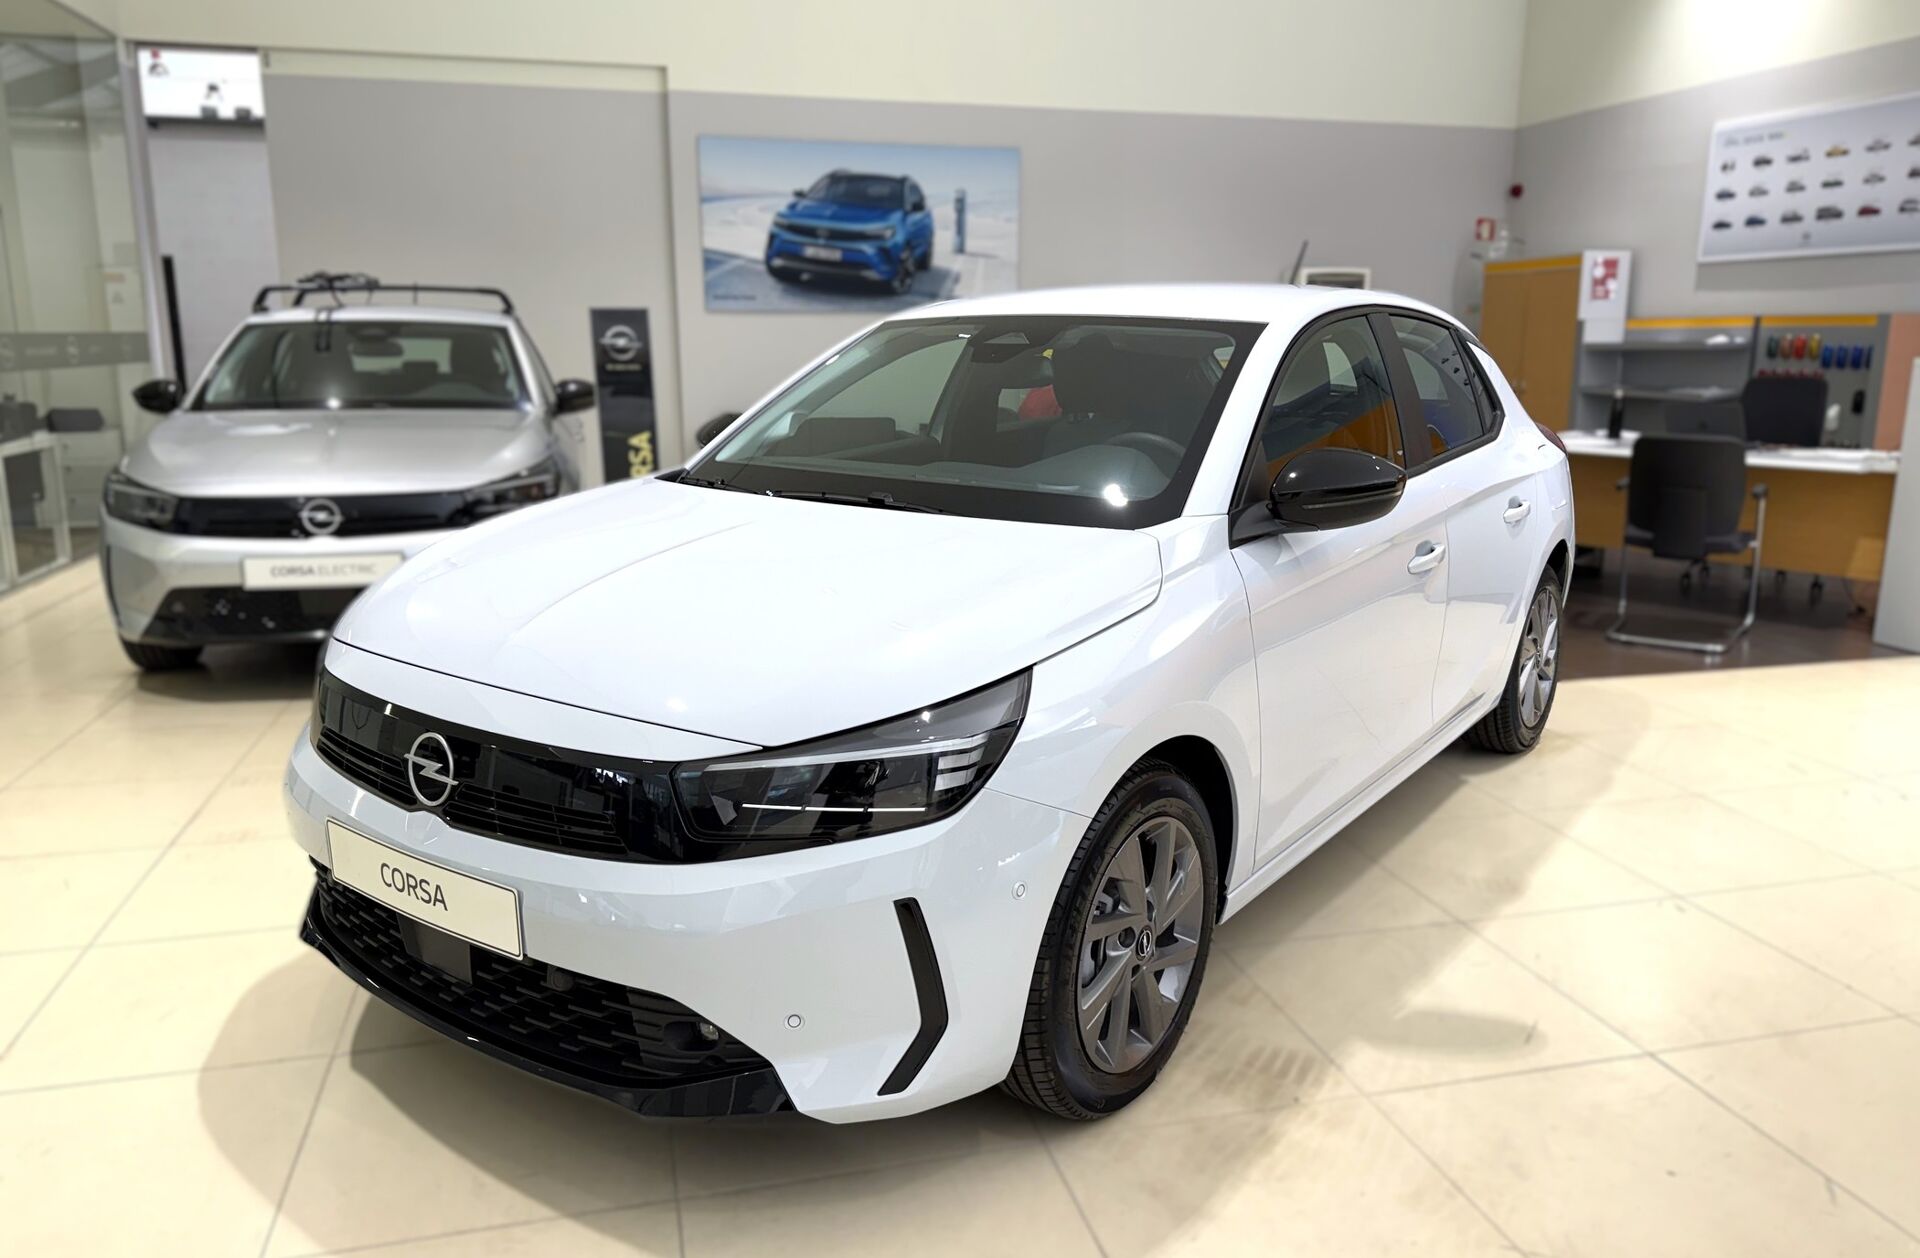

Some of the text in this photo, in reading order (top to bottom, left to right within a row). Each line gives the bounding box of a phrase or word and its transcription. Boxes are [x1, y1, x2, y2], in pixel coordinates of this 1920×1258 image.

[627, 430, 655, 478] RSA
[269, 562, 378, 578] CORSA ELECTRIC
[380, 862, 448, 912] CORSA
